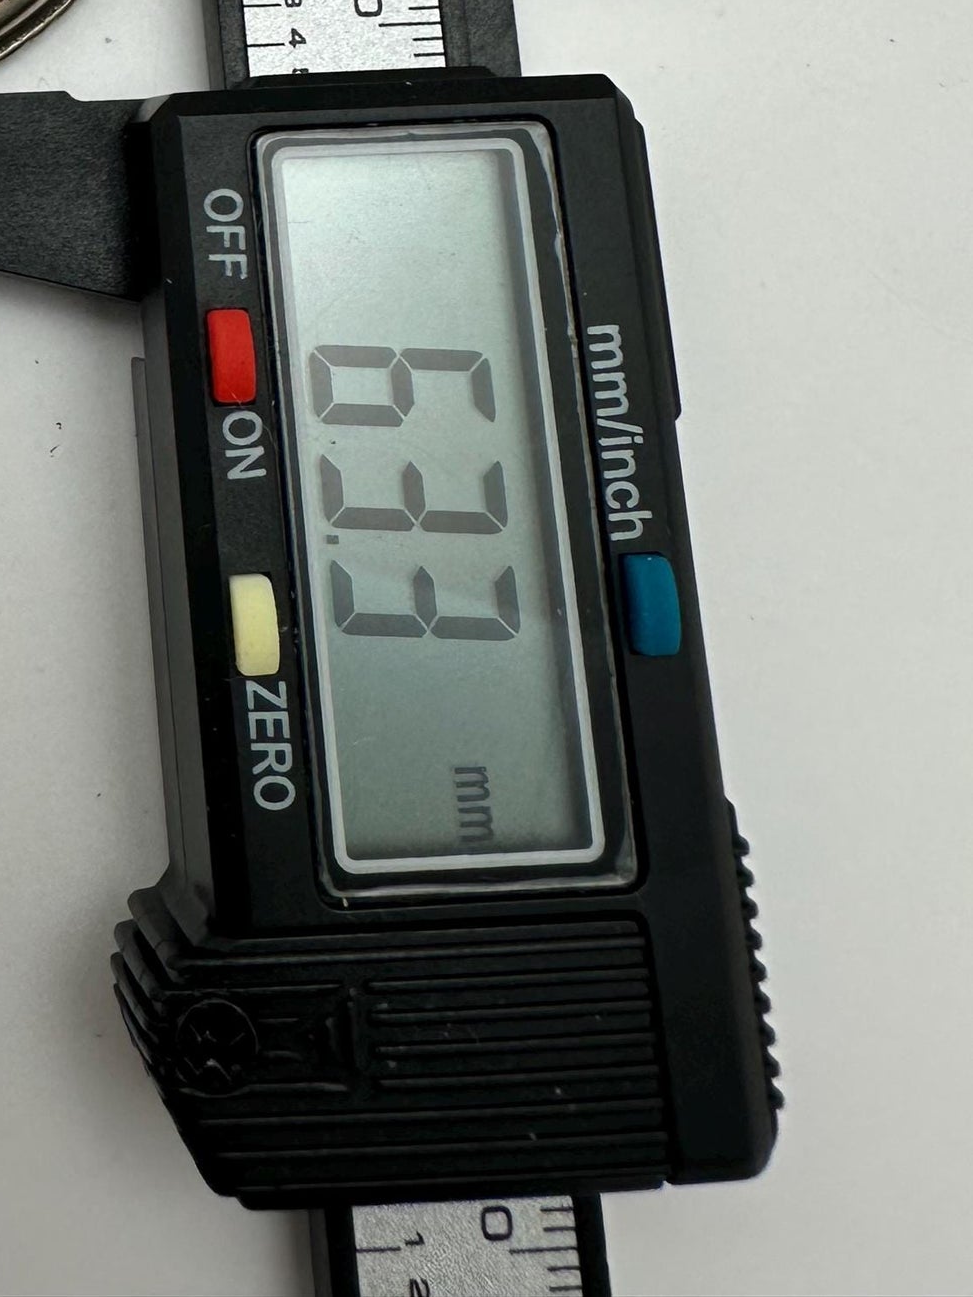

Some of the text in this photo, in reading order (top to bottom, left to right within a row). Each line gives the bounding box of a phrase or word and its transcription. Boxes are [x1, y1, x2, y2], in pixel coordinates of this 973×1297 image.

[289, 28, 307, 48] 4
[203, 189, 247, 280] OFF
[222, 412, 266, 480] ON
[587, 323, 652, 542] mm/inch
[309, 344, 521, 843] 63.3 mm
[245, 680, 296, 812] ZERO
[405, 1231, 425, 1246] 1
